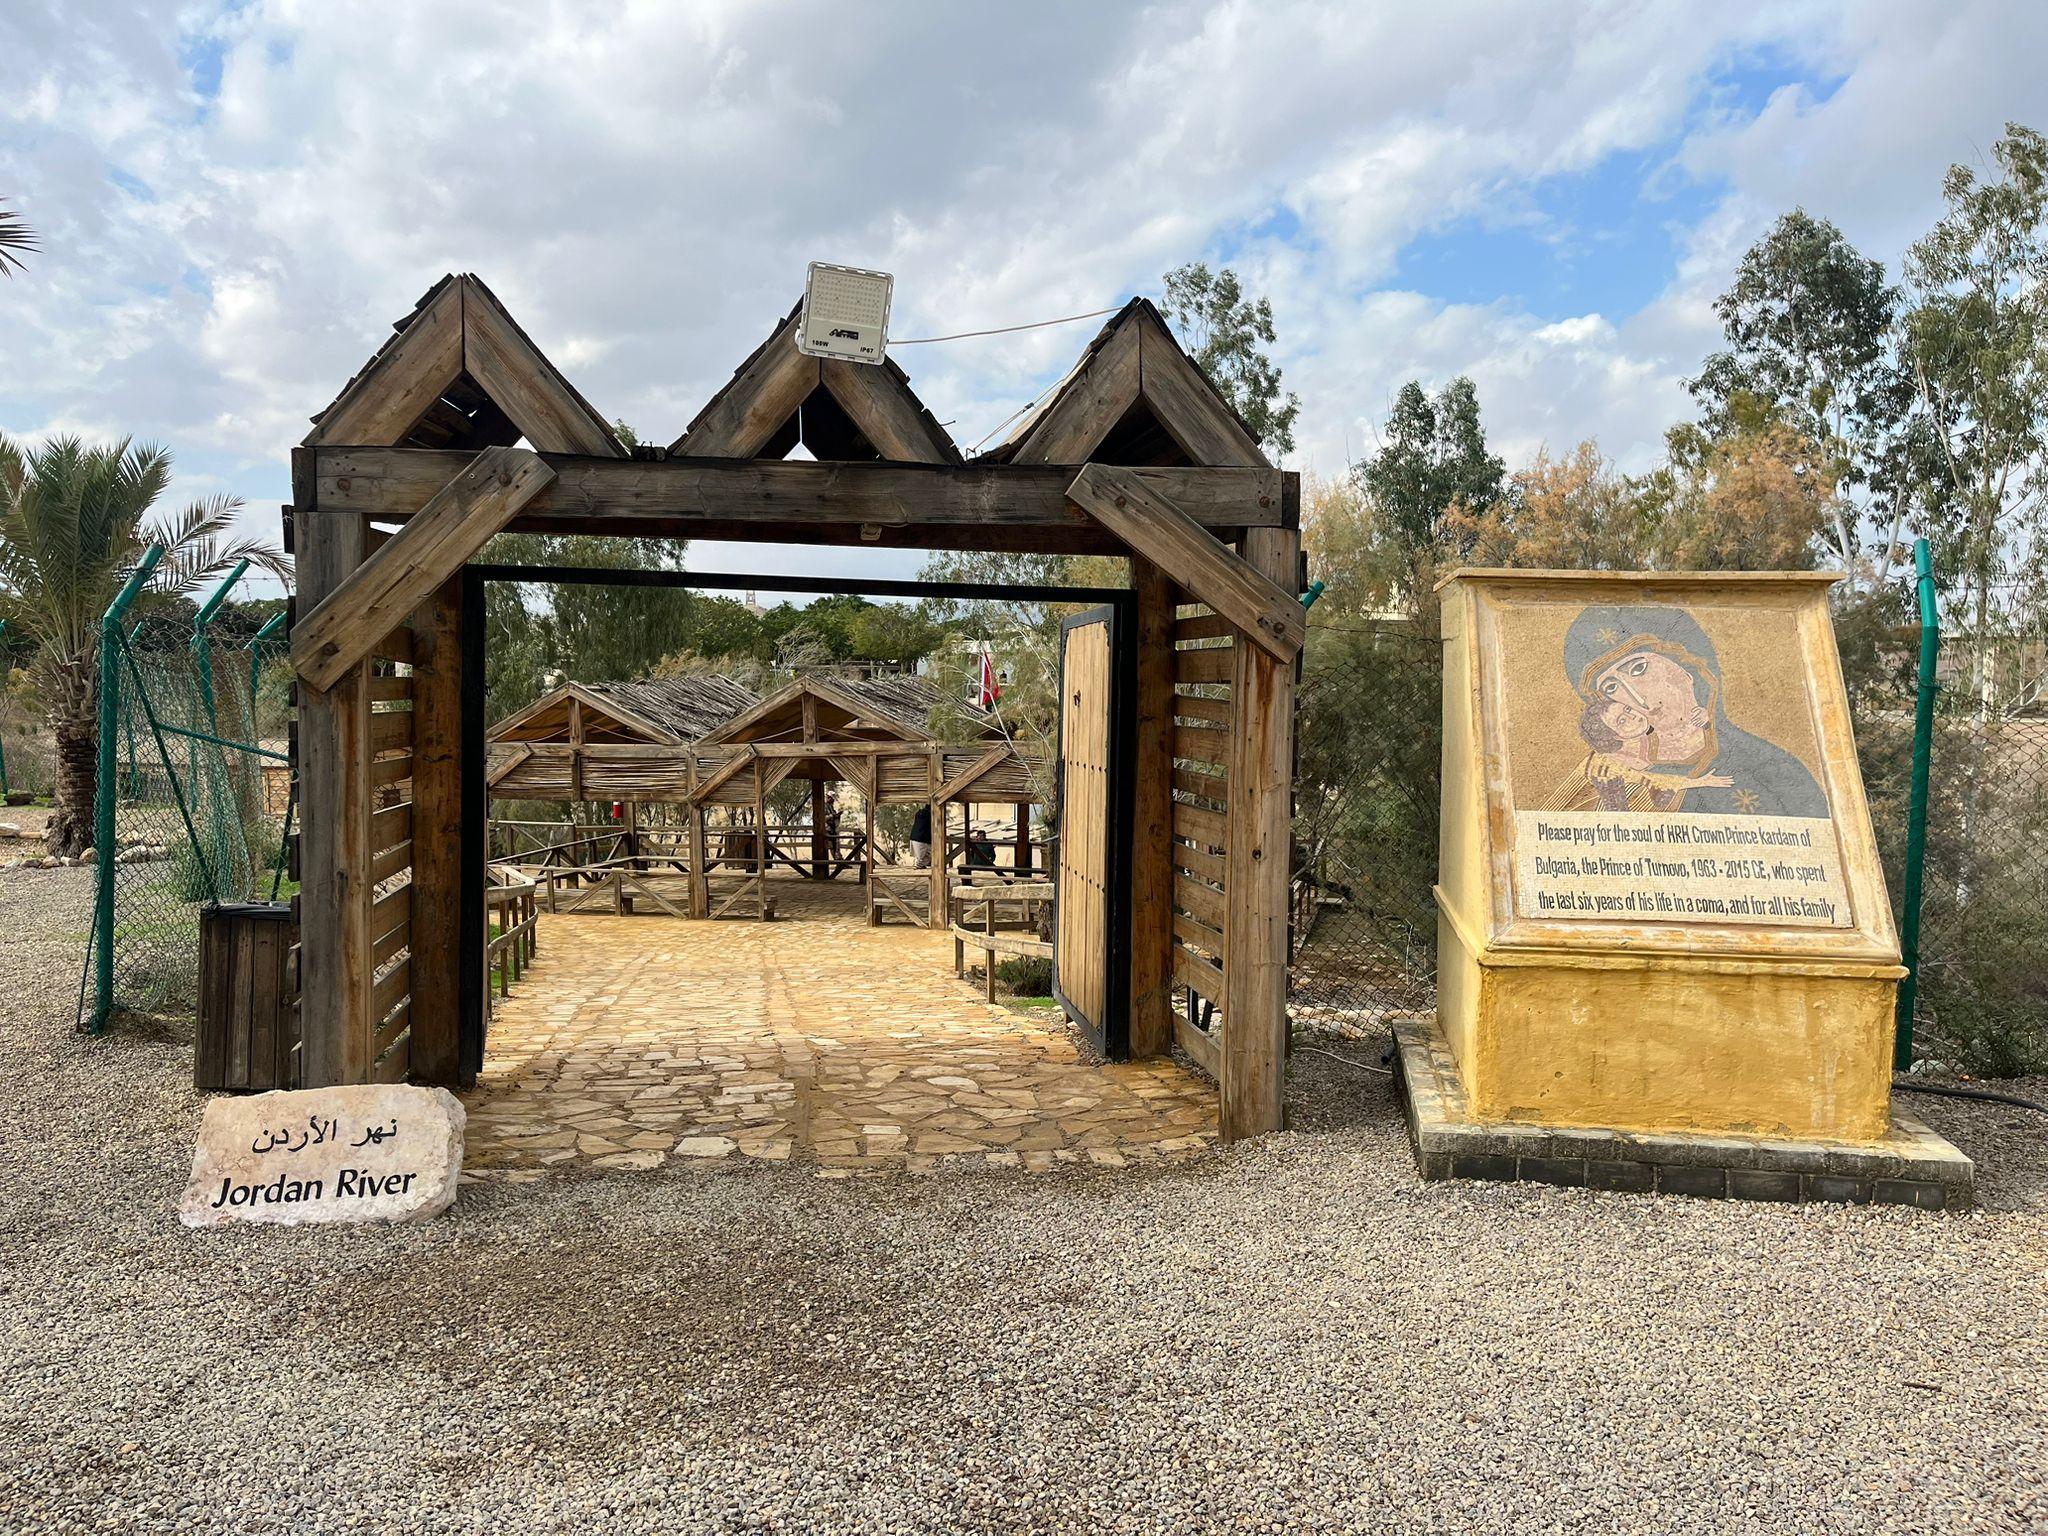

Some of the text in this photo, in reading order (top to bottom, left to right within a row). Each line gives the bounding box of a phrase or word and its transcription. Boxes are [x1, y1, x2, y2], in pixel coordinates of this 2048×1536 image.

[1538, 822, 1572, 841] Please
[1573, 829, 1595, 846] pray
[1596, 823, 1612, 842] for
[1614, 824, 1630, 842] the
[1632, 824, 1653, 843] soul
[1654, 824, 1666, 843] of
[1667, 825, 1691, 844] HRH
[1692, 826, 1725, 845] Crown
[1725, 826, 1758, 845] Prince
[1800, 829, 1812, 847] of
[1536, 856, 1580, 878] Bulgaria,
[1581, 857, 1598, 875] the
[1599, 857, 1631, 876] Prince
[1633, 858, 1644, 876] of
[1645, 858, 1690, 879] Turnovo,
[1691, 859, 1717, 878] 1963
[1725, 860, 1750, 879] 2015
[1752, 860, 1770, 881] CE,
[1771, 861, 1794, 880] who
[1797, 864, 1827, 886] spent
[1538, 891, 1555, 910] the
[1556, 891, 1577, 910] last
[1578, 891, 1595, 910] six
[1595, 894, 1624, 913] years
[1625, 892, 1636, 911] of
[1638, 892, 1653, 912] his
[1655, 892, 1672, 912] life
[1674, 893, 1686, 912] in
[1687, 897, 1694, 913] a
[1750, 895, 1766, 915] for
[1768, 896, 1783, 916] all
[1784, 896, 1801, 917] his
[1801, 897, 1836, 924] family
[252, 1115, 398, 1154] نهر الأردن
[211, 1168, 418, 1209] Jordan River
